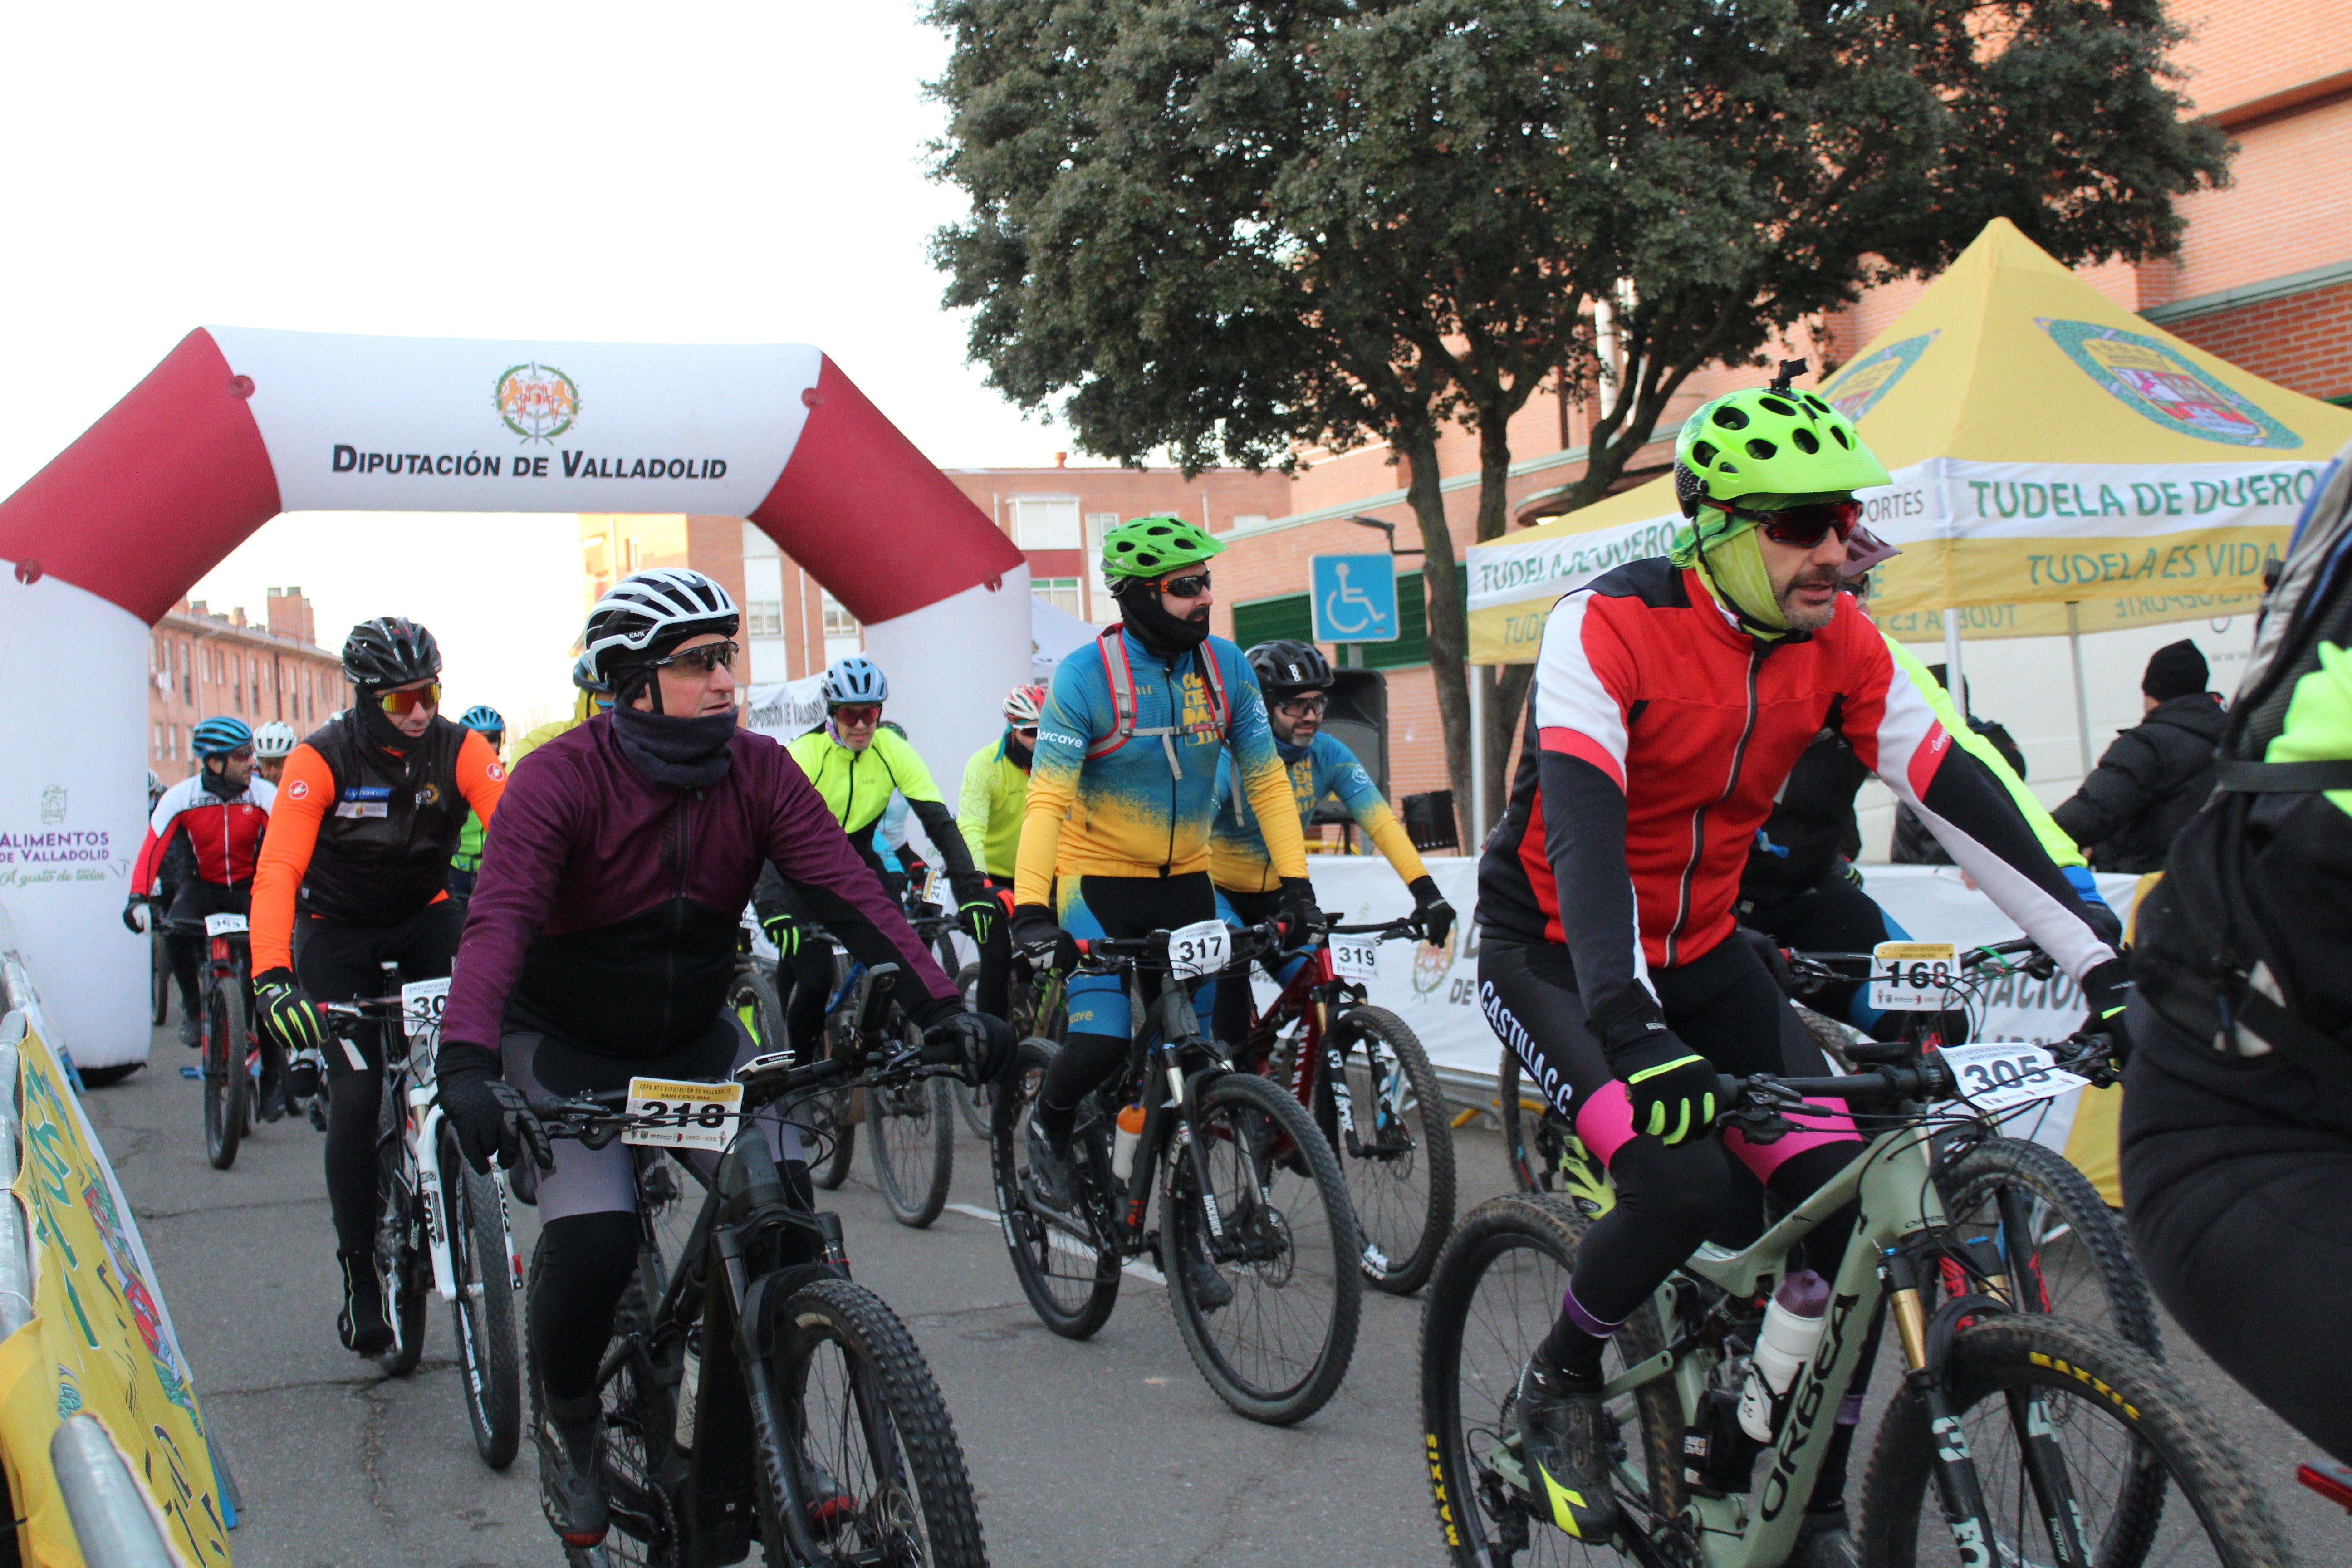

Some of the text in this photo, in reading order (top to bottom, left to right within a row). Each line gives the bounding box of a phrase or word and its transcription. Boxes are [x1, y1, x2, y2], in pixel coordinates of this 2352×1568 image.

[332, 444, 728, 480] DIPUTACIÓN DE VALLADOLID
[1867, 490, 1923, 522] ORTES
[1968, 469, 2317, 518] TUDELA DE DUERO
[2027, 542, 2278, 585] TUDELA ES VIDA
[1288, 664, 1301, 682] POC
[0, 832, 109, 848] ALIMENTOS
[0, 849, 109, 863] DE VALLADOLID
[0, 869, 106, 888] A gusto de todos
[1180, 936, 1222, 962] 317
[1338, 947, 1374, 966] 319
[1886, 961, 1950, 989] 168
[1449, 978, 1475, 1005] DE
[413, 994, 447, 1017] 30
[1480, 980, 1545, 1085] CASTILLA
[1964, 1055, 2051, 1093] 305
[638, 1101, 726, 1128] 218
[1761, 1293, 1860, 1522] ORBEA
[1426, 1433, 1460, 1546] MAXXIS
